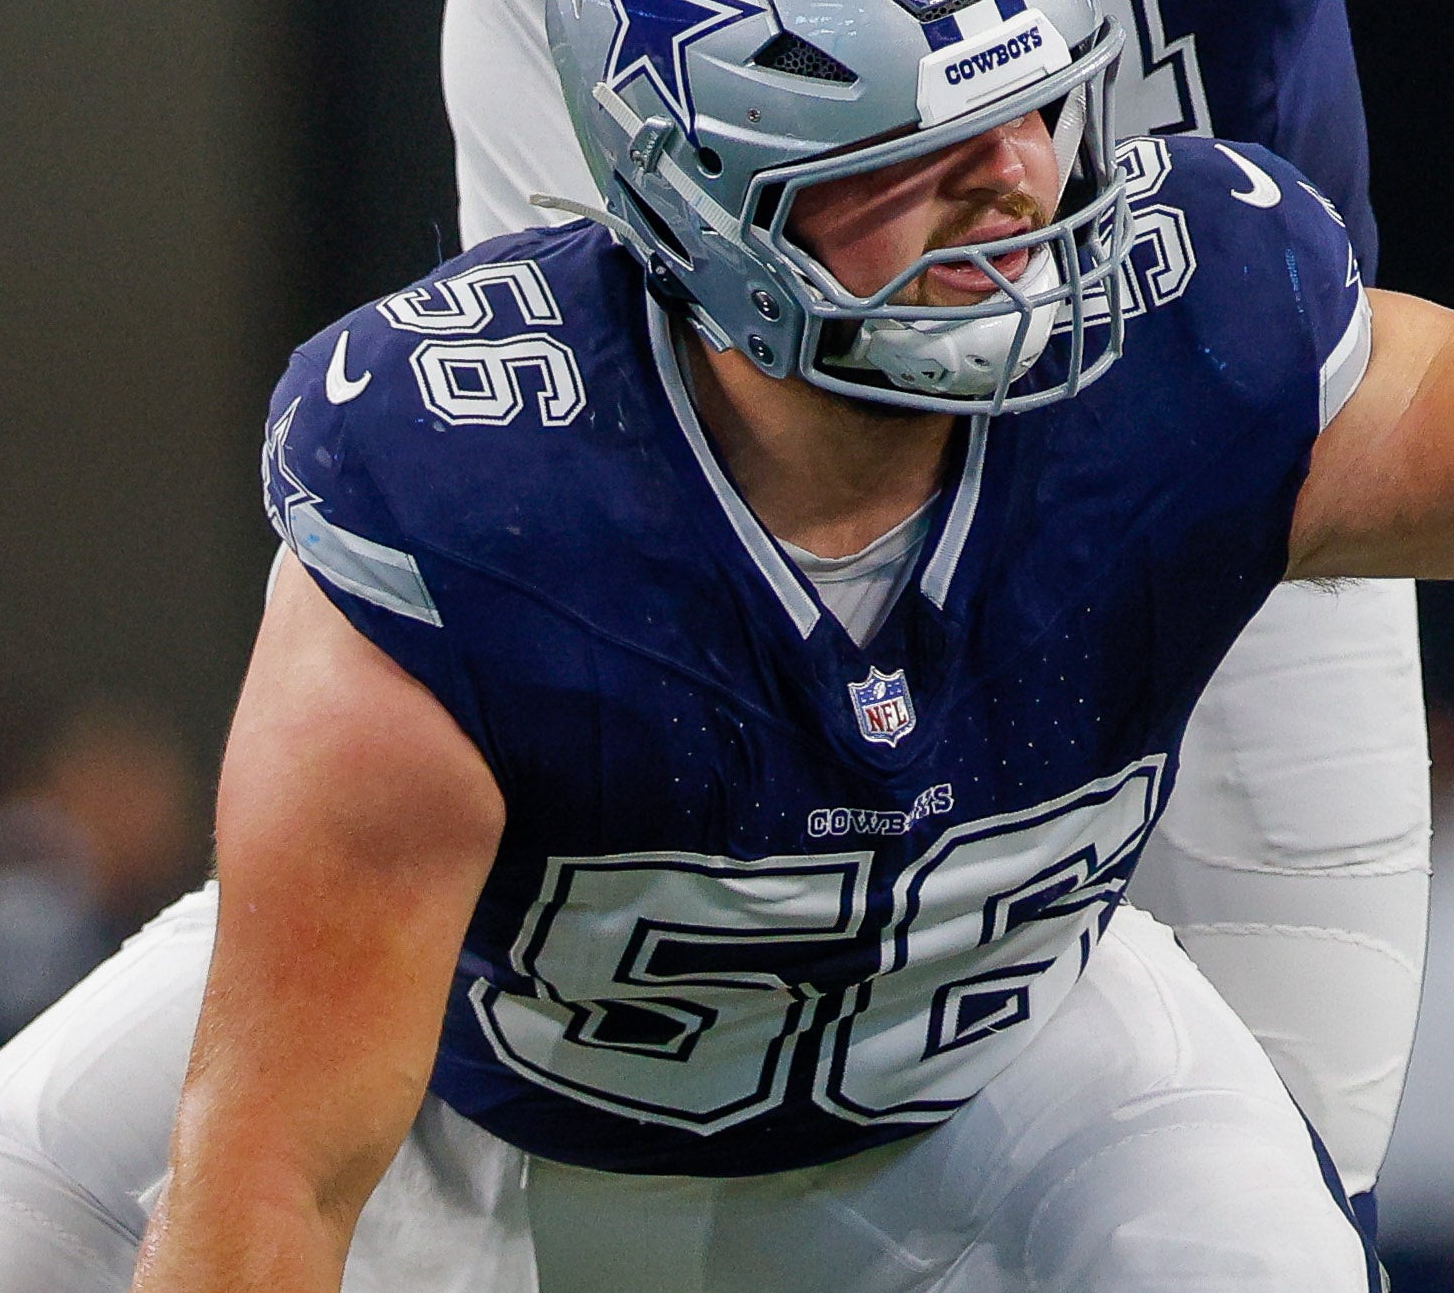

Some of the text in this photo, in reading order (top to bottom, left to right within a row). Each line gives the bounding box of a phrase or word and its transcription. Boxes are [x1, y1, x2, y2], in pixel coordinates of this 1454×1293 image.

[945, 26, 1042, 85] COWBOYS
[376, 260, 587, 426] 56
[865, 700, 907, 733] NFL
[807, 783, 955, 838] COWBYS
[471, 753, 1168, 1138] 56
